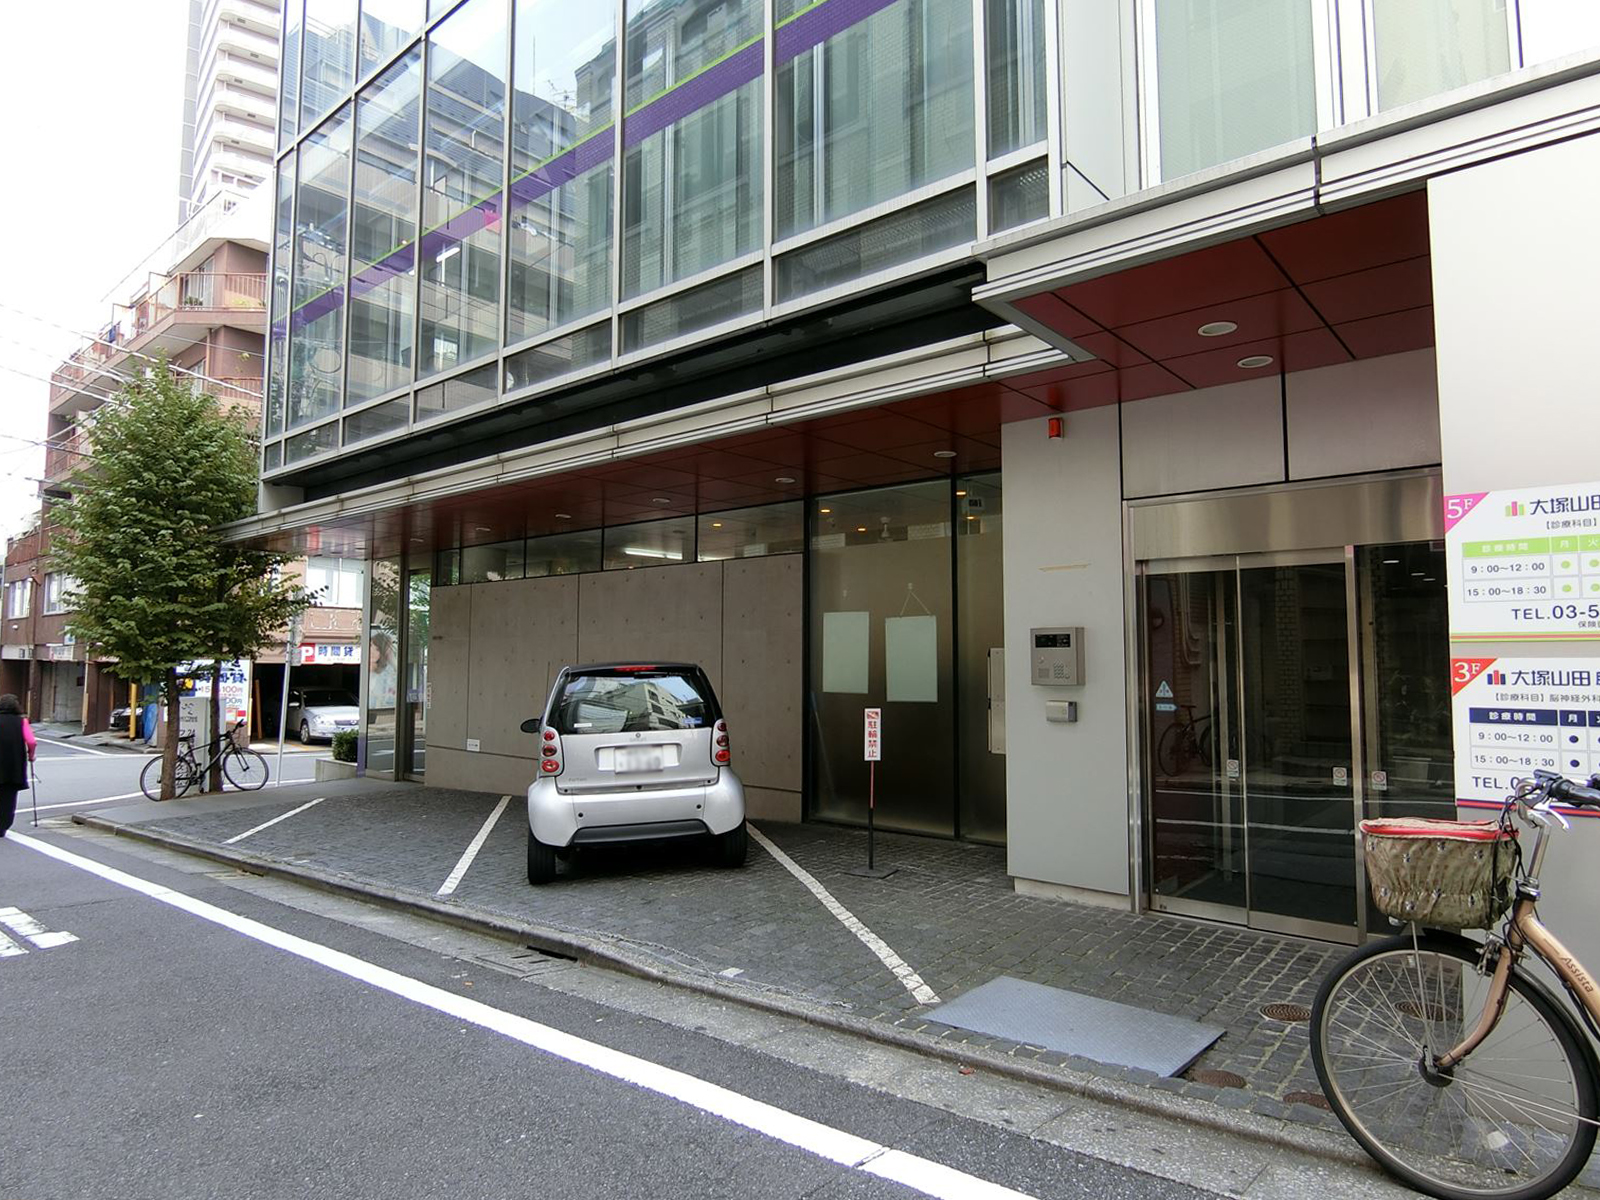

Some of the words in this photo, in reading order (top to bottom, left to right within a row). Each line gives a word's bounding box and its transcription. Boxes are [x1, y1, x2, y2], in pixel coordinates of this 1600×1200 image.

[1446, 498, 1474, 519] 5F
[1560, 540, 1570, 549] 月
[1454, 661, 1481, 683] 3F
[1511, 669, 1592, 687] 大塚山田
[1488, 711, 1537, 722] 診療時間
[1567, 713, 1578, 723] 月
[1559, 957, 1594, 993] Assista
